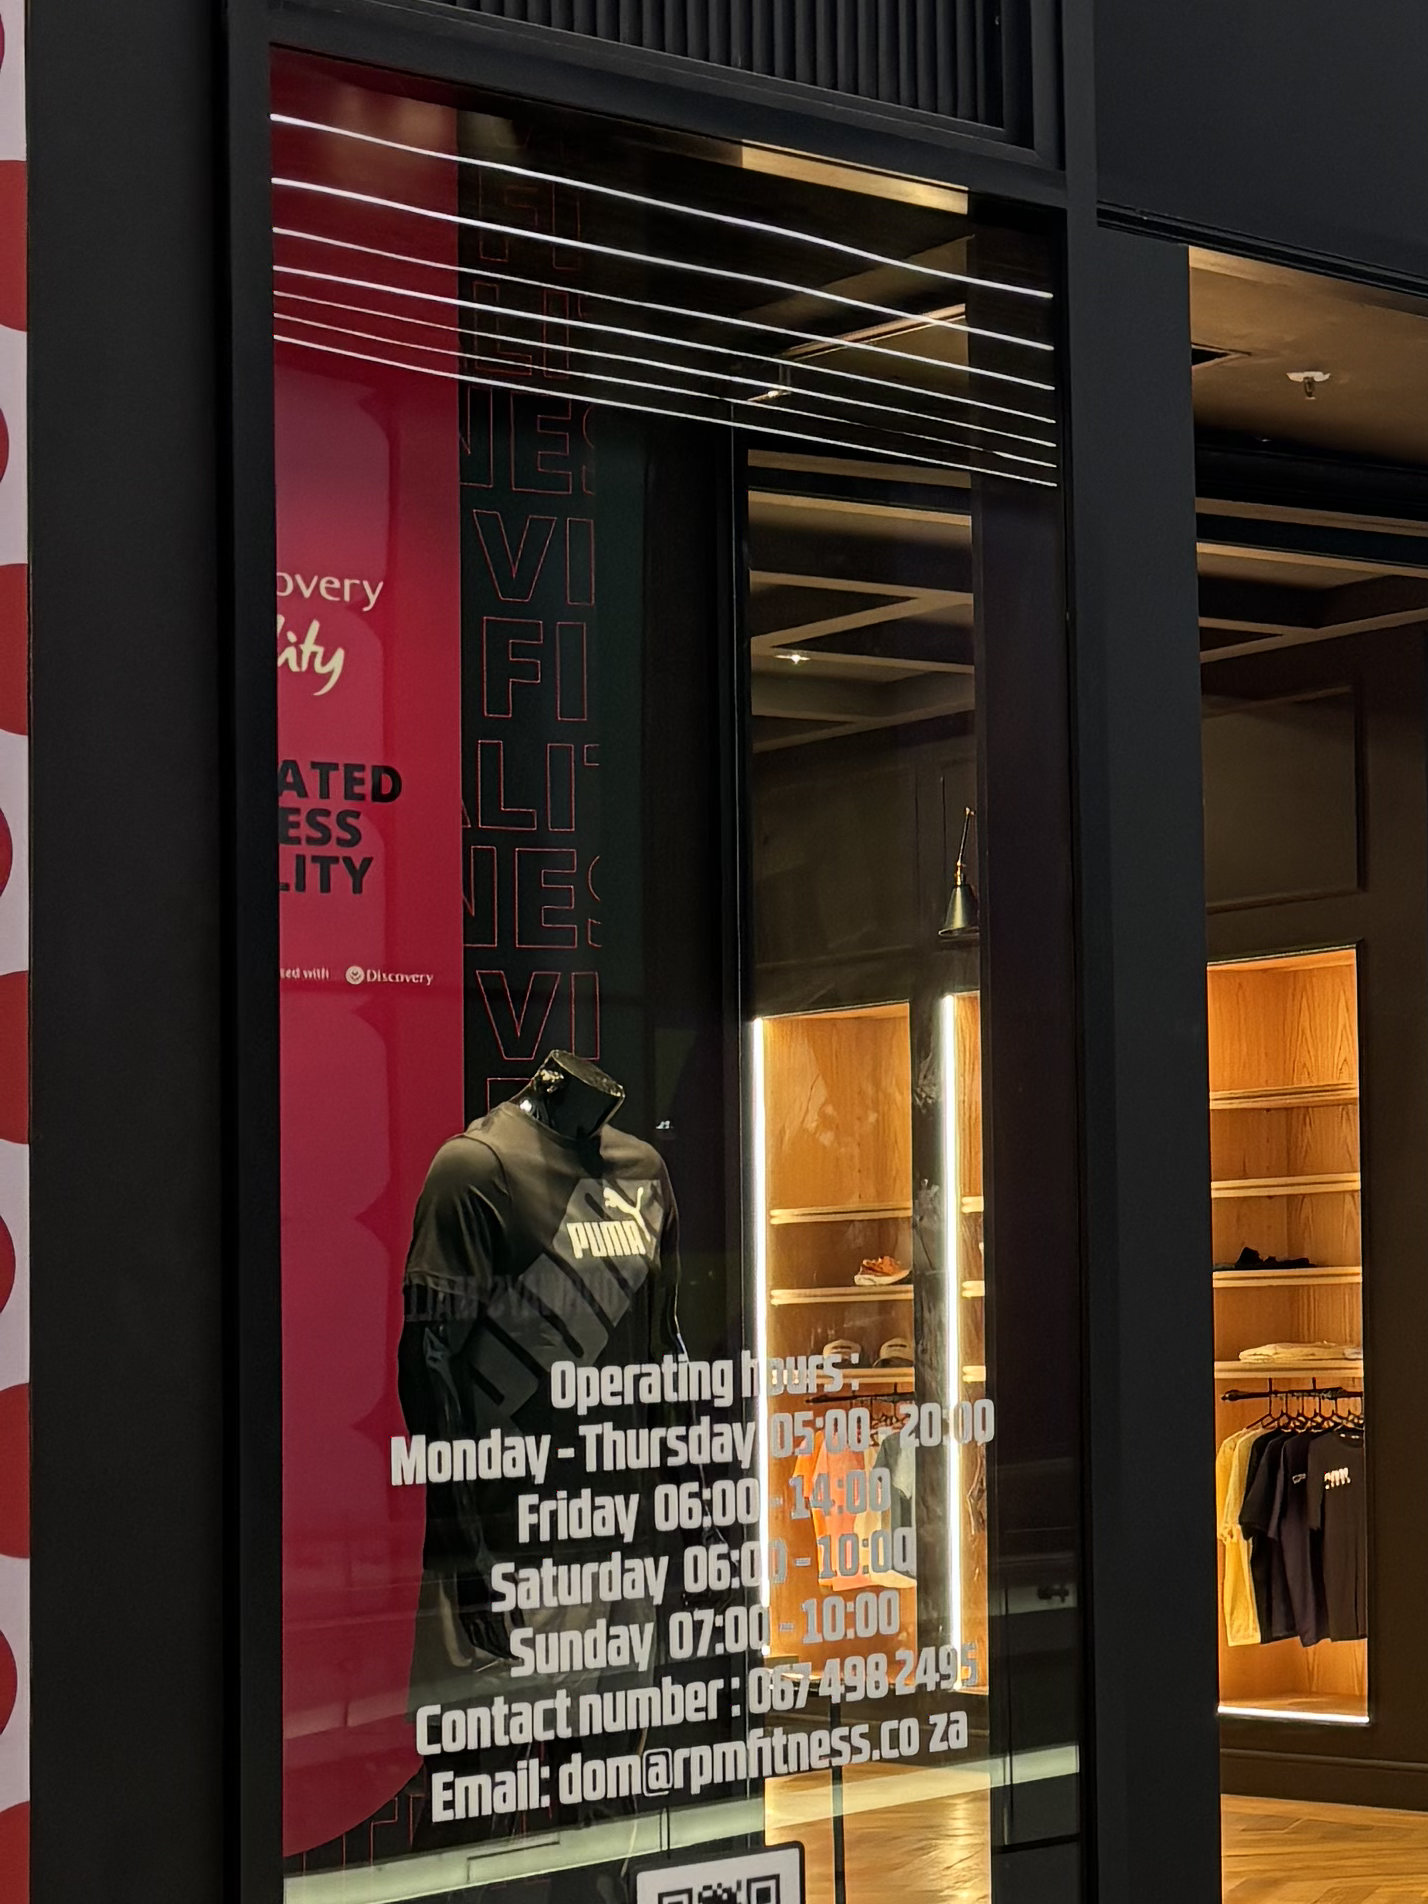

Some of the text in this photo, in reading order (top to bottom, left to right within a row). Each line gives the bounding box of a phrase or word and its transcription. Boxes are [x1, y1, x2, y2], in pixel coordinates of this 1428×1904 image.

[366, 968, 434, 986] Discovery
[566, 1220, 647, 1259] PUMA
[551, 1352, 735, 1416] Operating
[741, 1348, 844, 1399] hours
[390, 1427, 551, 1487] Monday
[556, 1446, 575, 1459] -
[578, 1415, 757, 1473] Thursday
[770, 1406, 871, 1459] 05:00
[517, 1488, 640, 1544] Friday
[654, 1477, 761, 1532] 06:00
[788, 1467, 893, 1521] 14:00
[490, 1550, 669, 1614] Saturday
[683, 1537, 788, 1594] 06:00
[816, 1526, 917, 1581] 10:00
[509, 1618, 655, 1678] Sunday
[668, 1603, 771, 1661] 07:00
[801, 1589, 901, 1645] 10:00
[415, 1688, 573, 1757] Contact
[578, 1675, 725, 1738] number
[748, 1661, 813, 1715] 067
[818, 1652, 889, 1705] 498
[894, 1641, 979, 1696] 2495
[430, 1757, 551, 1824] Email:
[928, 1710, 969, 1753] za
